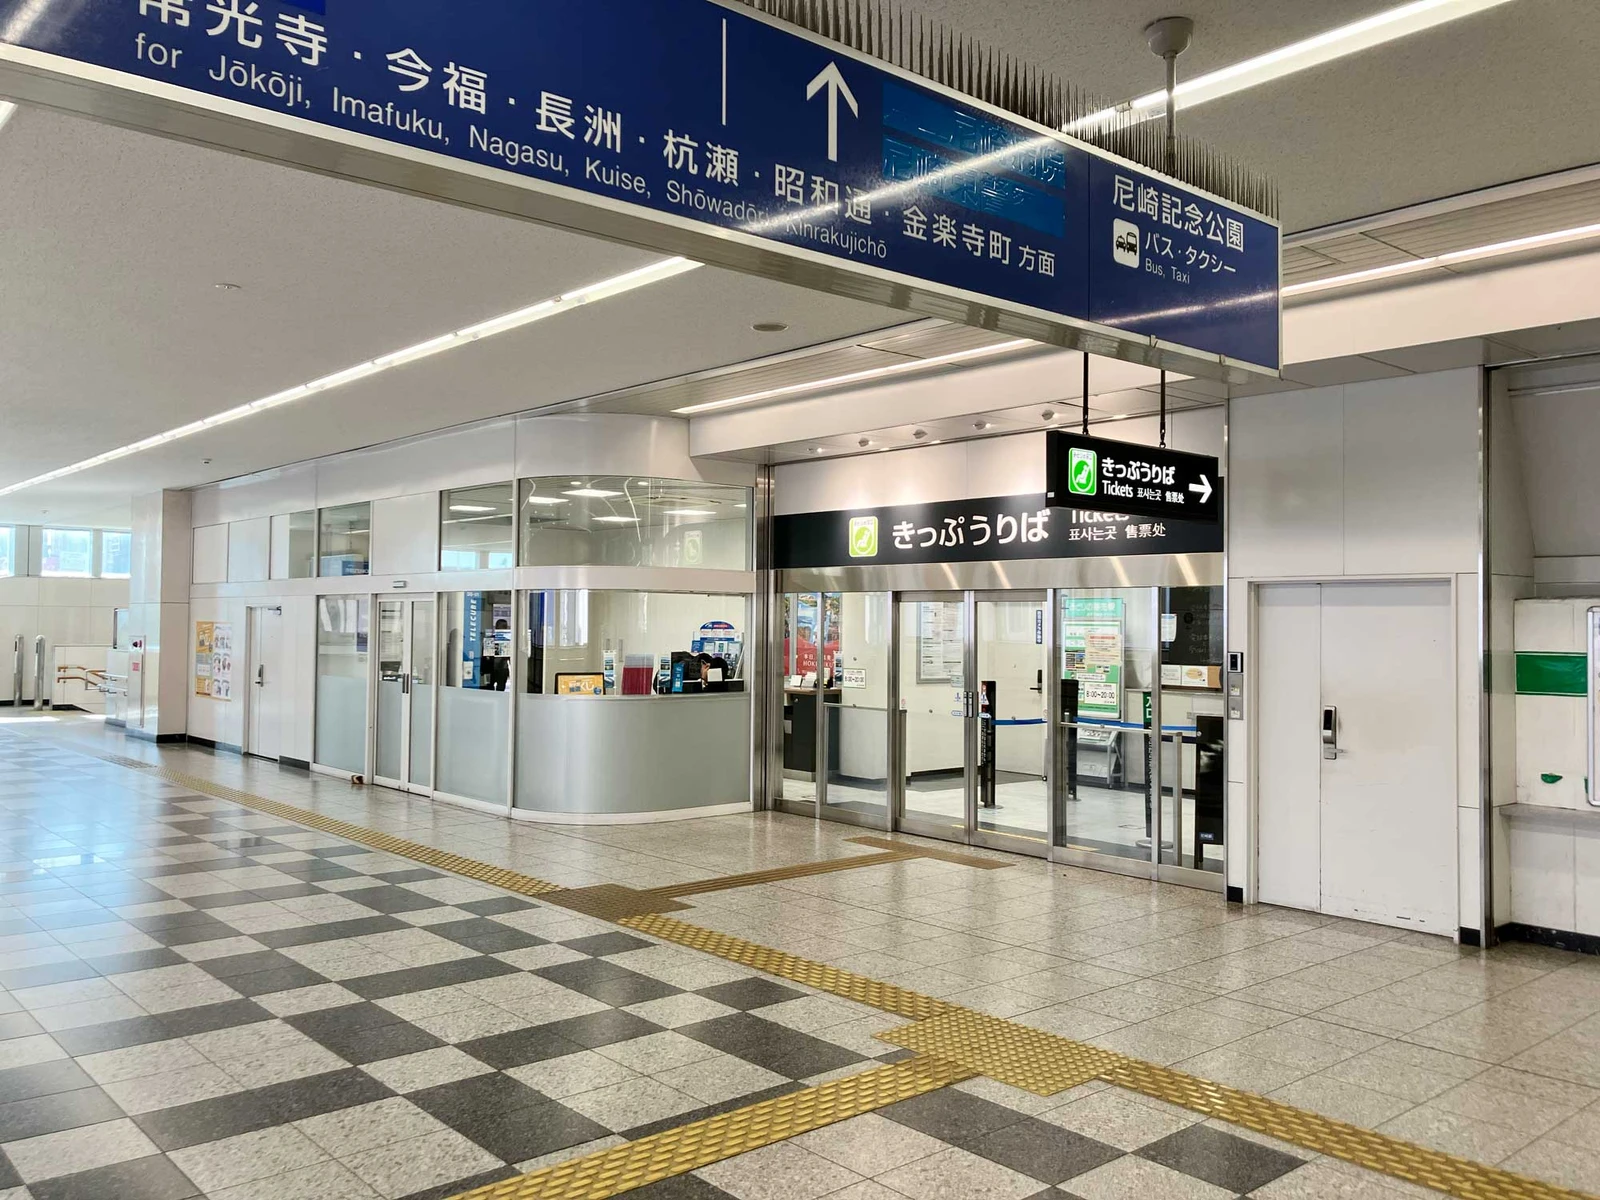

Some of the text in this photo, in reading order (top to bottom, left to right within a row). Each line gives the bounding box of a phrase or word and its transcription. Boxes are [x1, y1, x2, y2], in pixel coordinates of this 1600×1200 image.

[134, 32, 183, 69] for
[208, 55, 311, 109] Jōkōji,
[332, 86, 450, 144] Imafuku,
[468, 125, 570, 177] Nagasu,
[584, 157, 652, 199] Kuise,
[1113, 174, 1245, 254] 尼崎記念公園
[1144, 258, 1191, 285] Bus, Taxi
[1101, 457, 1176, 485] きっぷうりば
[1101, 480, 1133, 498] Tickets
[891, 508, 1051, 550] きっぷうりば
[1068, 522, 1166, 541] 표사는곳 售票处
[469, 598, 478, 642] TELECUBE
